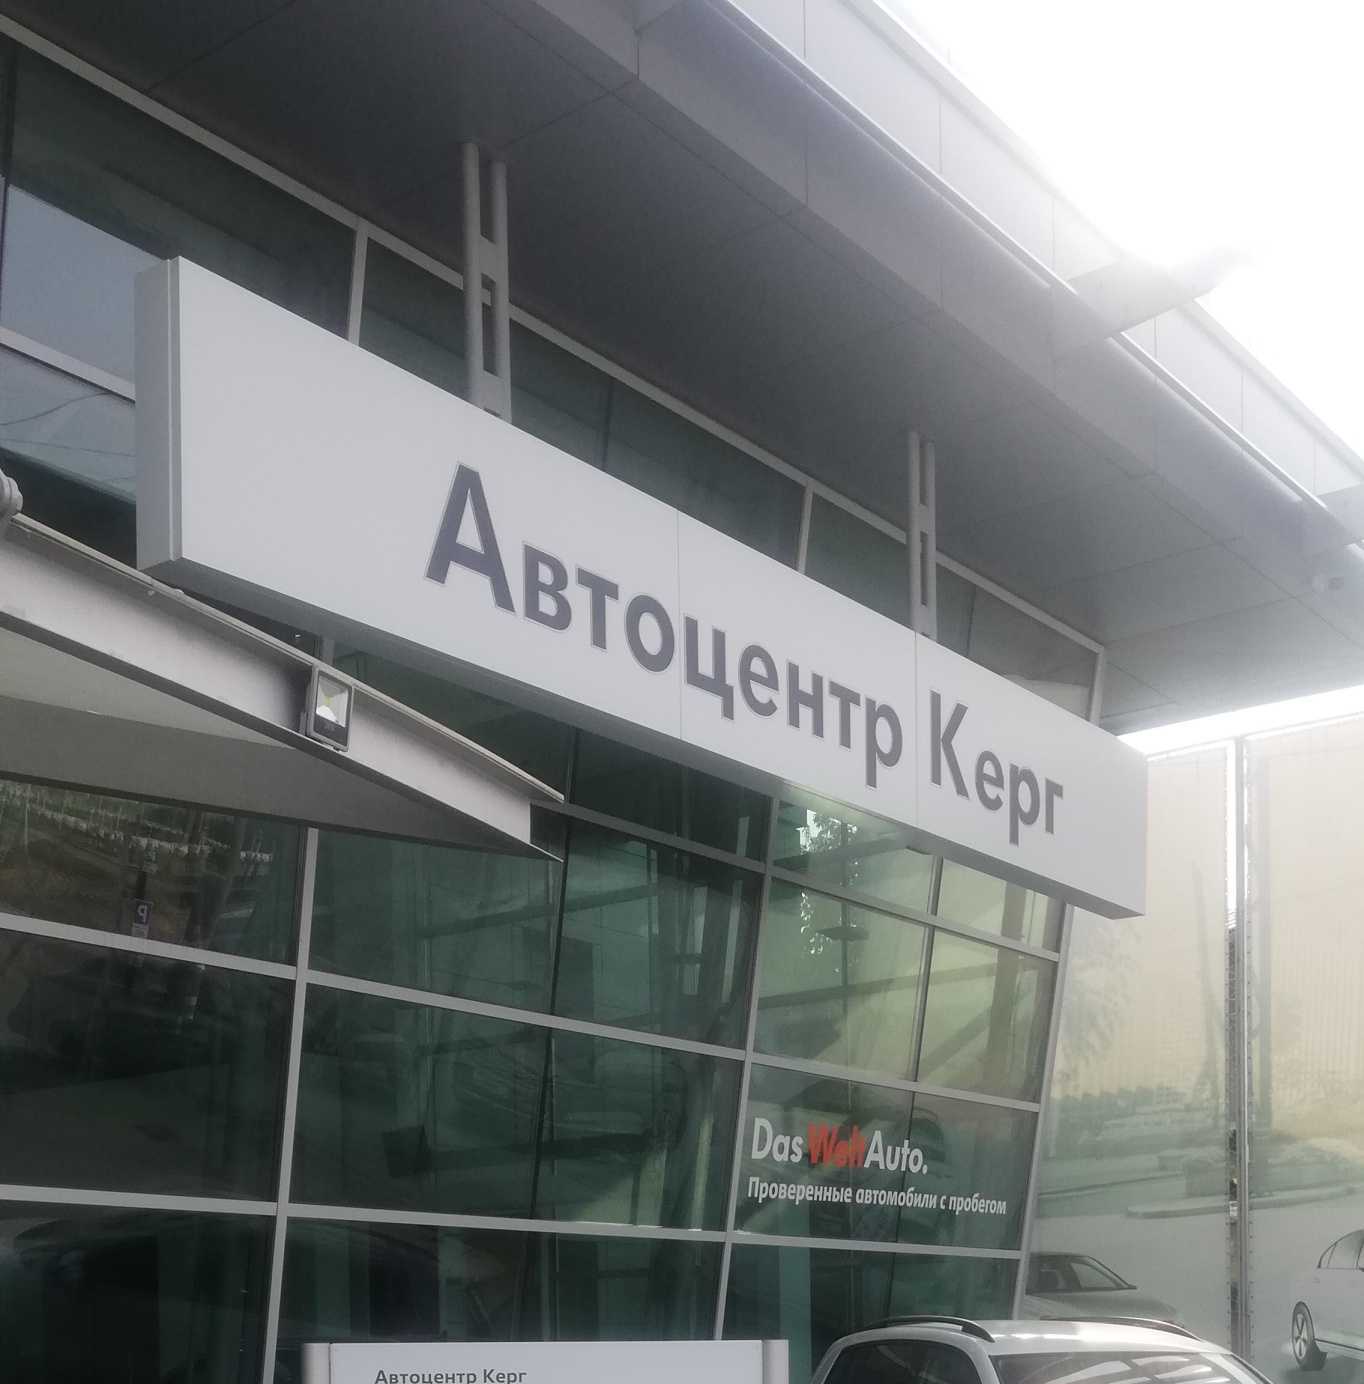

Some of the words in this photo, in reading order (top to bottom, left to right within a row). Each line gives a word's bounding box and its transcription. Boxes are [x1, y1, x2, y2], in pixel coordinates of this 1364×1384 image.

[425, 461, 904, 789] Автоцентр
[929, 688, 1064, 847] Керг
[751, 1117, 803, 1162] Das
[748, 1176, 853, 1205] Проверенные
[855, 1187, 937, 1209] автомобили
[939, 1195, 947, 1209] с
[948, 1194, 1007, 1216] пробегом
